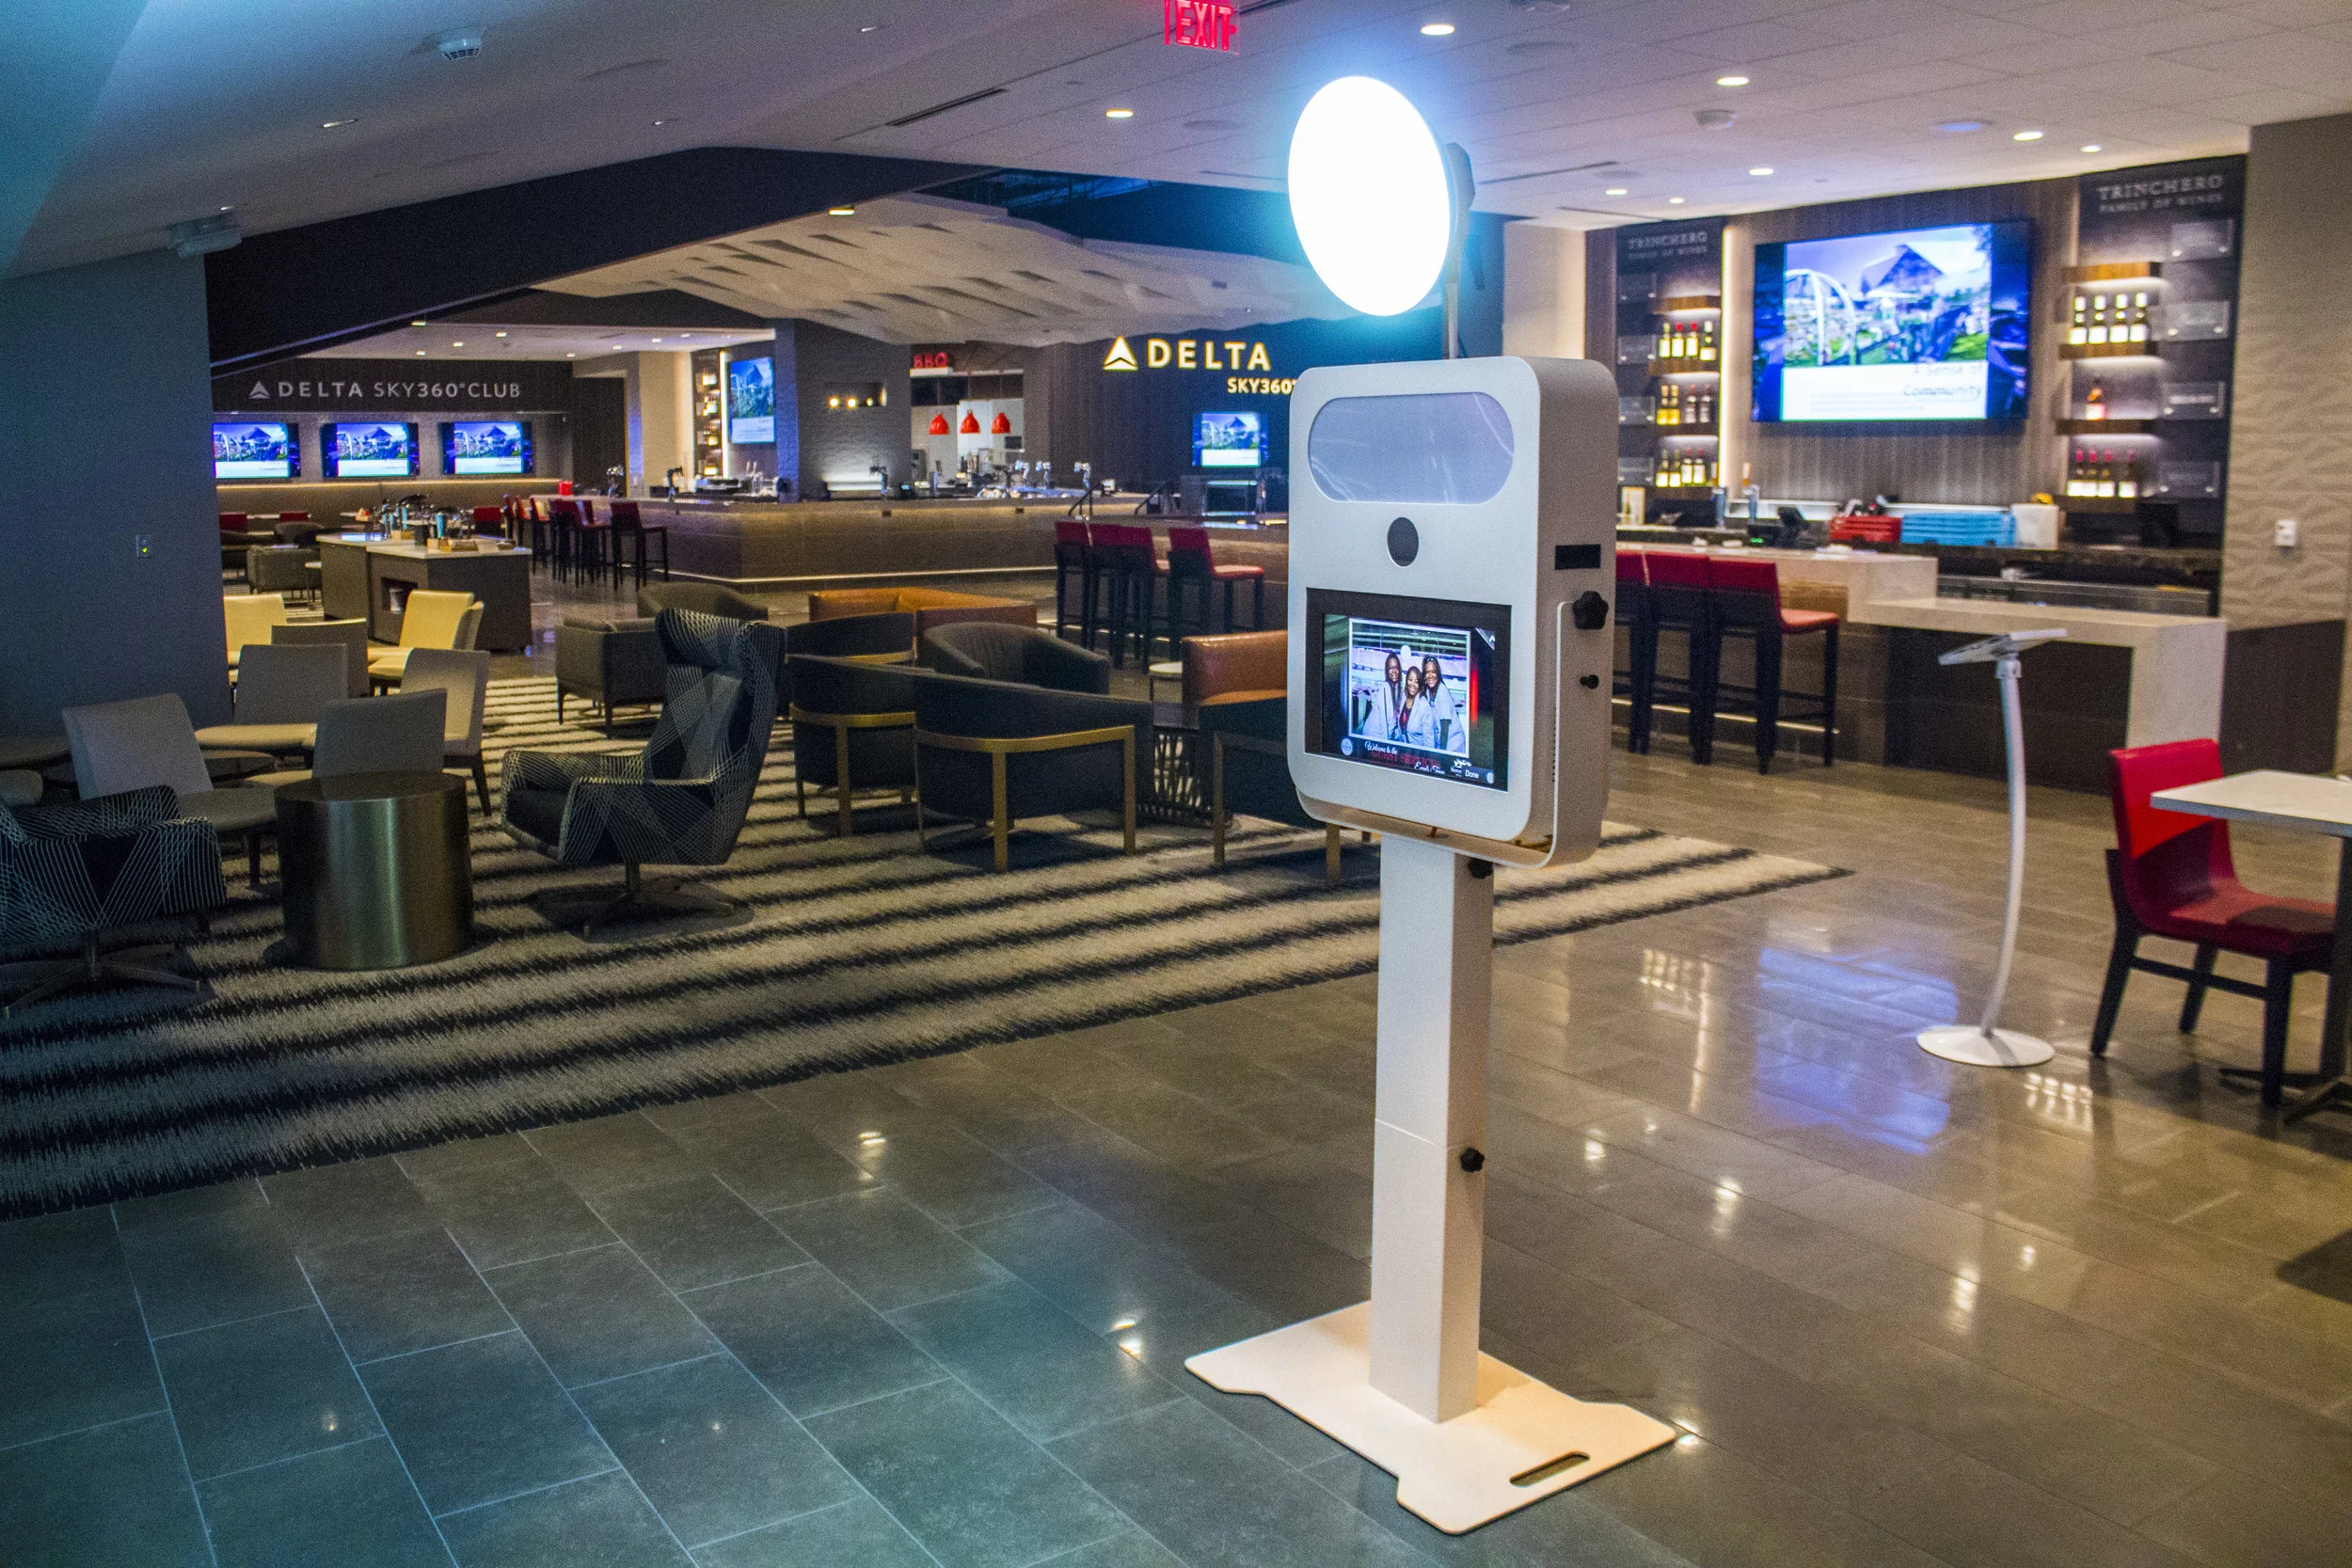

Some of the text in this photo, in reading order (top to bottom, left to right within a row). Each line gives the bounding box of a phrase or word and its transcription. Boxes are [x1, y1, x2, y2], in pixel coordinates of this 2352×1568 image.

[1175, 0, 1233, 51] EXIT
[2096, 174, 2223, 200] TRINCHERO
[1147, 338, 1272, 372] DELTA
[278, 381, 363, 398] DELTA
[1903, 384, 1980, 400] Community
[1465, 769, 1480, 779] Done
